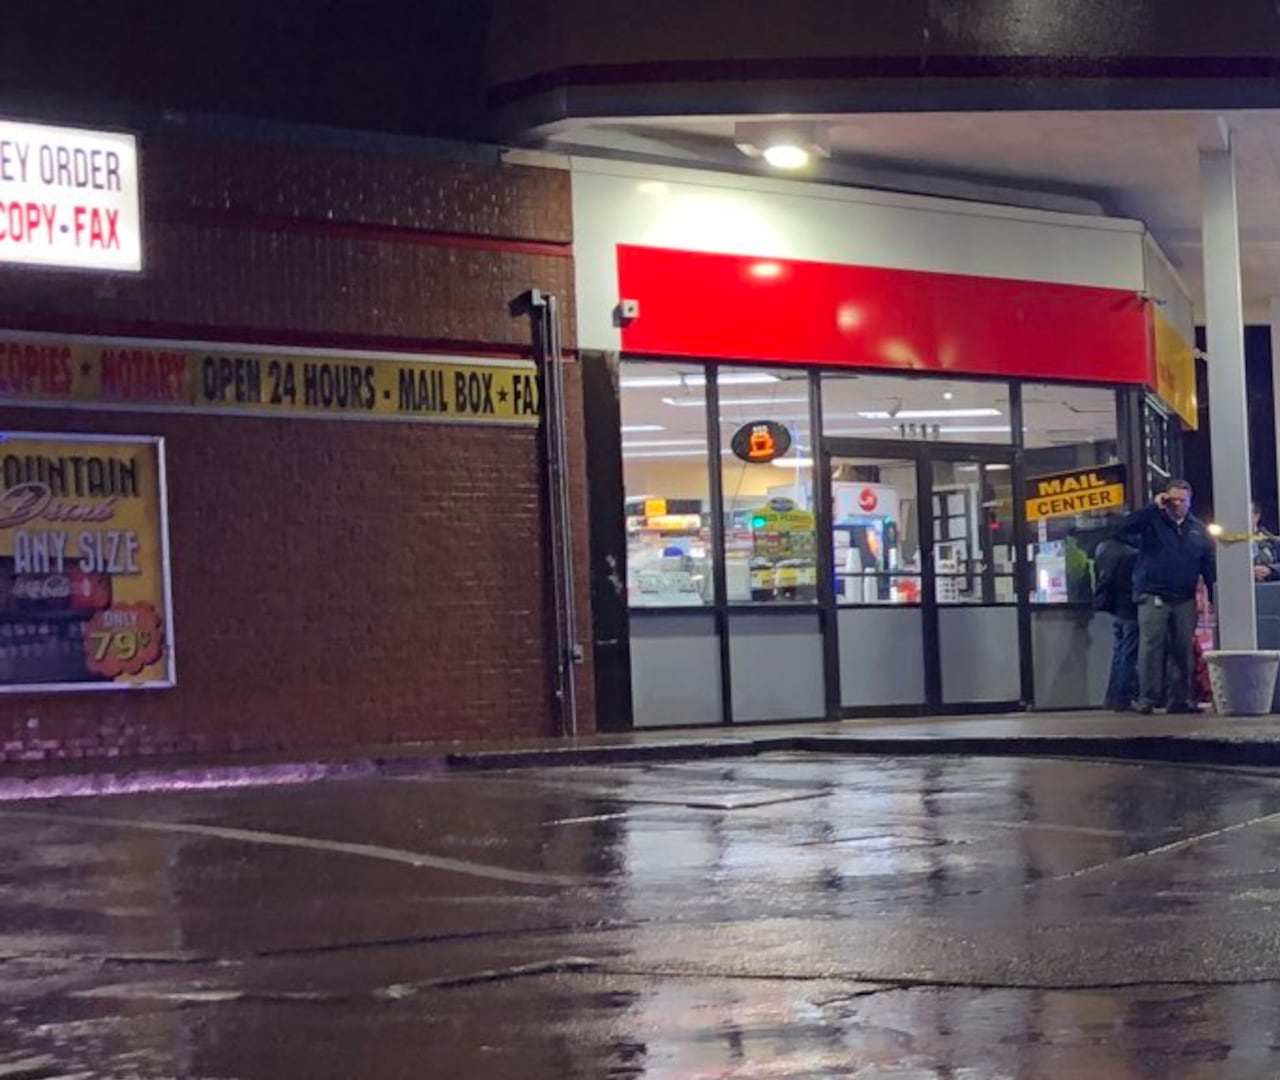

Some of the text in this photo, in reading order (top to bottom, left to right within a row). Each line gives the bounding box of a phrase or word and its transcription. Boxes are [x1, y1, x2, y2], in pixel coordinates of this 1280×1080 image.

[39, 143, 122, 192] ORDER
[73, 205, 121, 251] FAX
[203, 355, 262, 403] OPEN
[268, 359, 297, 404] 24
[304, 363, 376, 410] HOURS
[399, 367, 448, 412] MAIL
[454, 371, 496, 414] BOX
[1036, 490, 1113, 516] CENTER
[1037, 473, 1106, 497] MAIL
[15, 530, 142, 575] ANY SIZE
